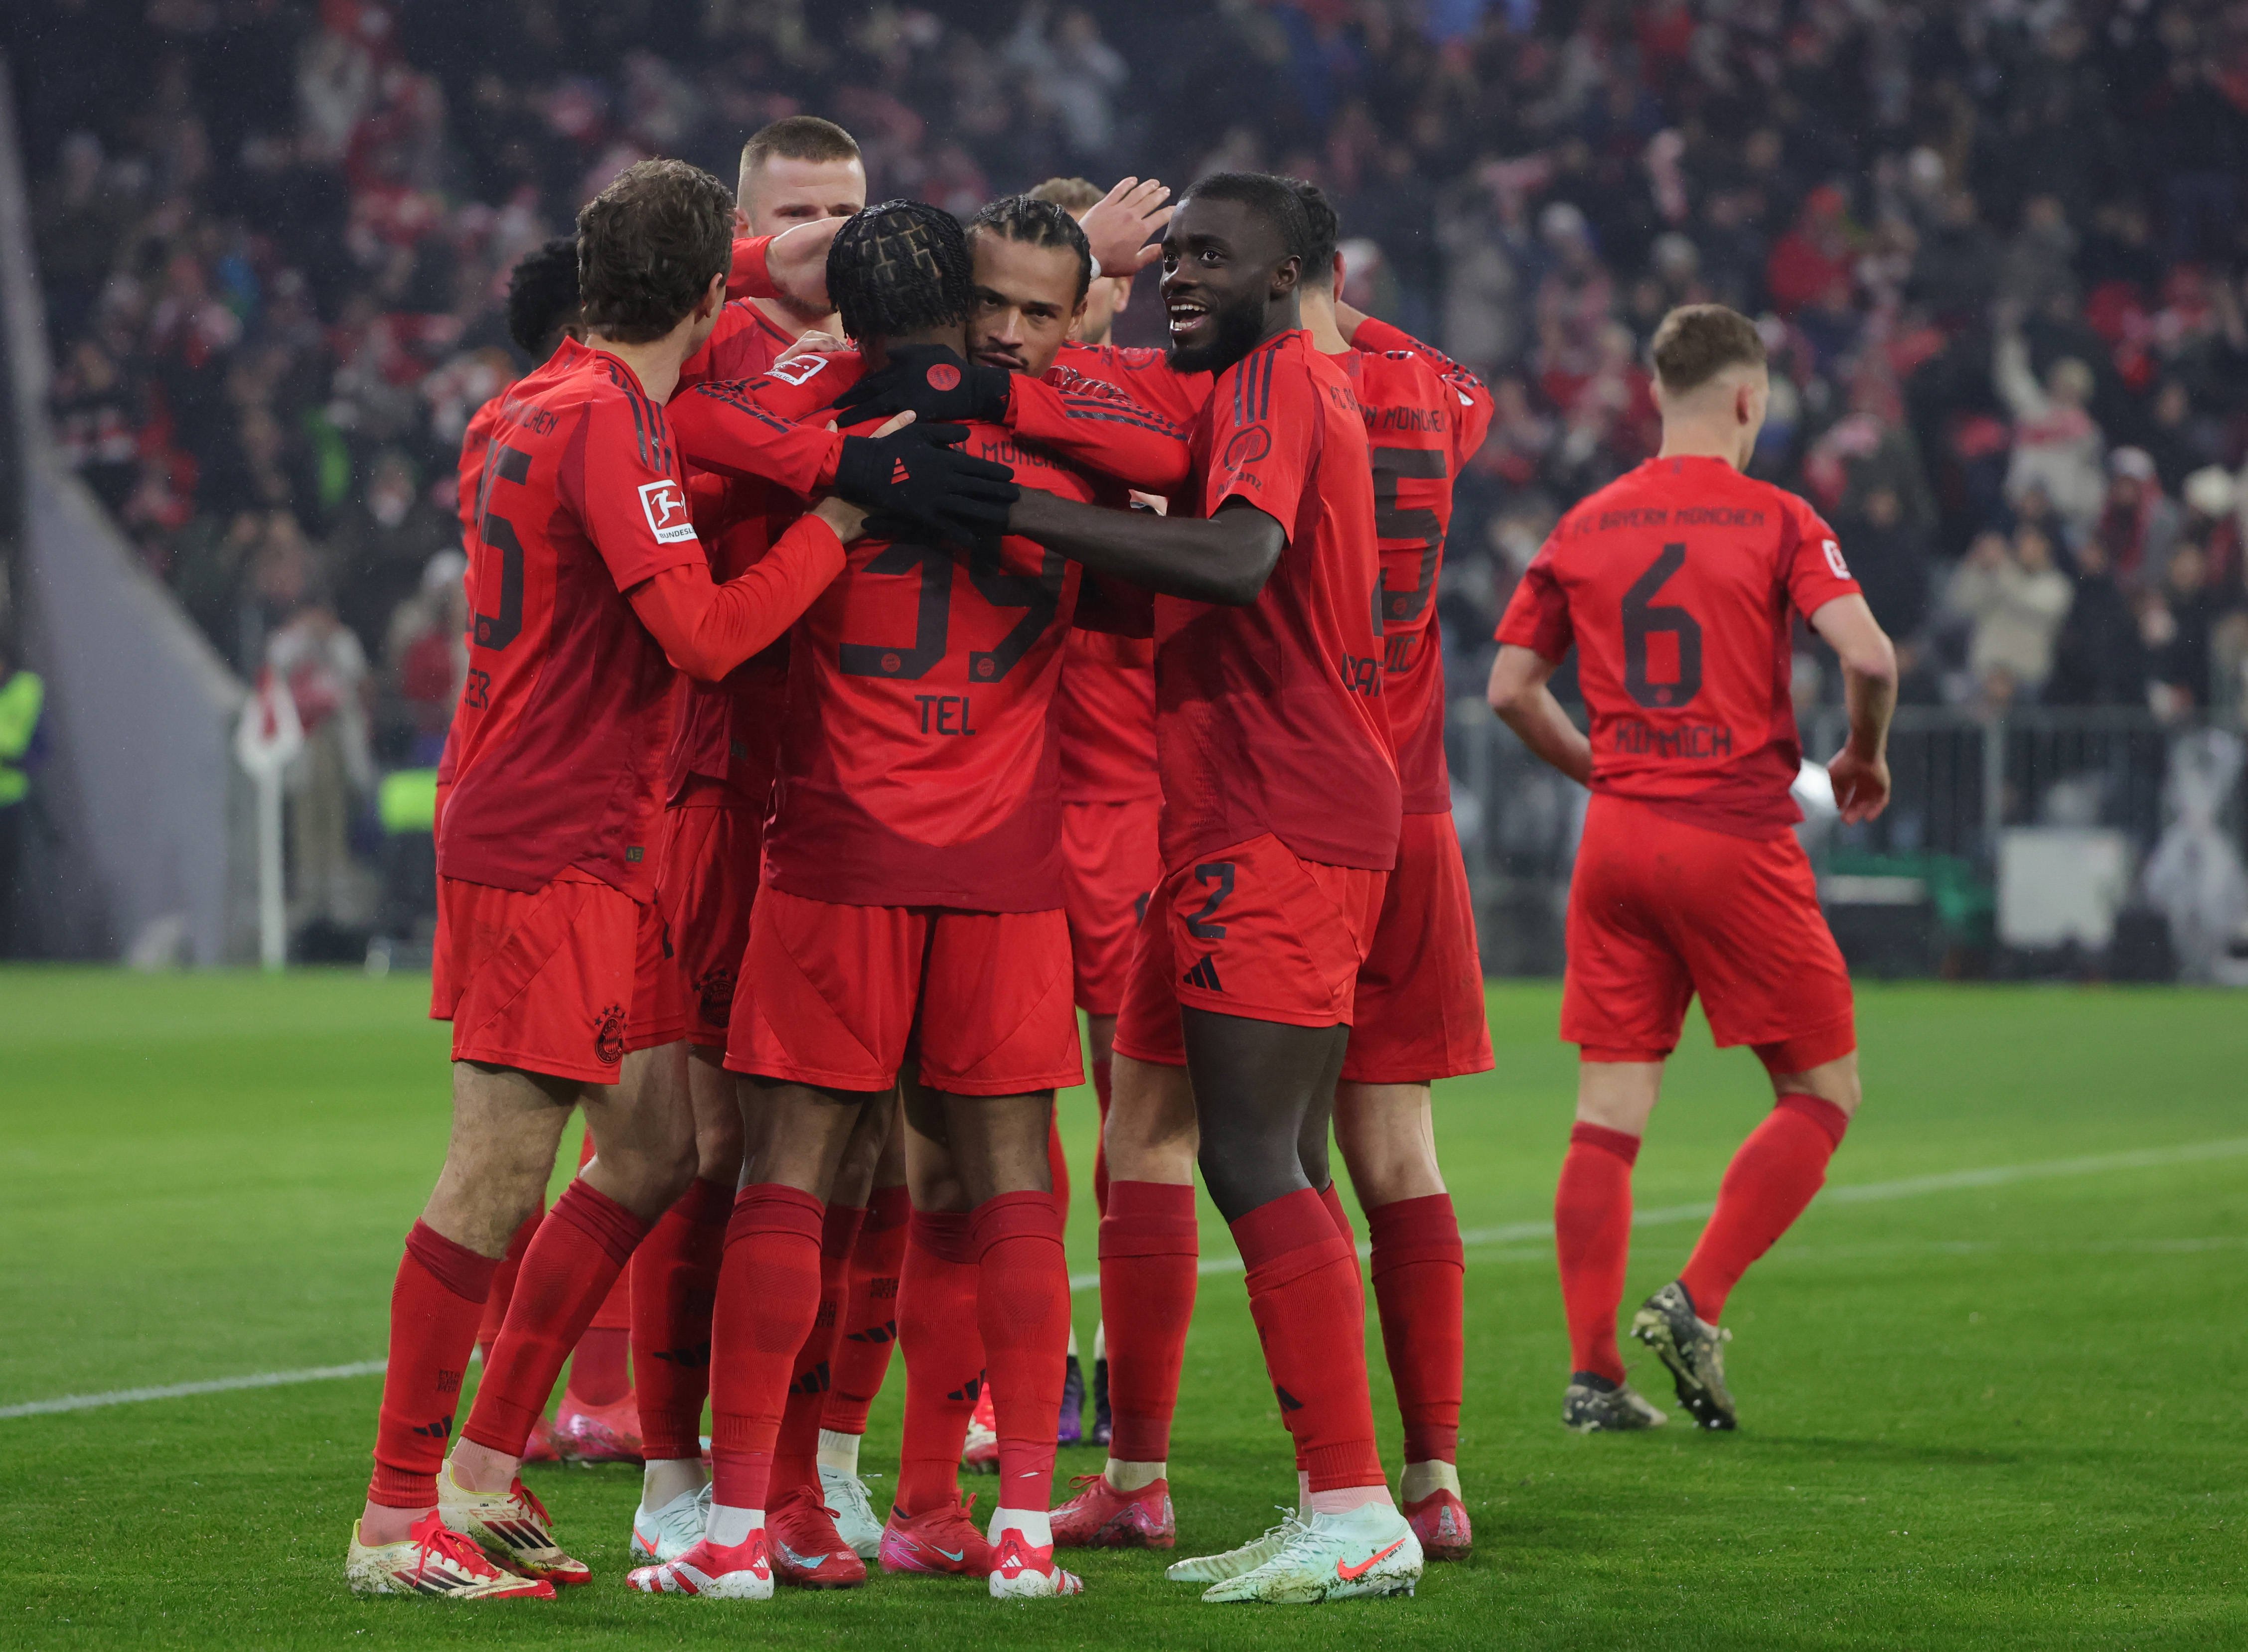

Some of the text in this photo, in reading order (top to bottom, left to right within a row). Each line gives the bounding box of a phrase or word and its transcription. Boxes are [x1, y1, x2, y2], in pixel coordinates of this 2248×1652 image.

[1622, 542, 1702, 708] 6
[914, 694, 977, 736] TEL
[1186, 862, 1235, 939] 2
